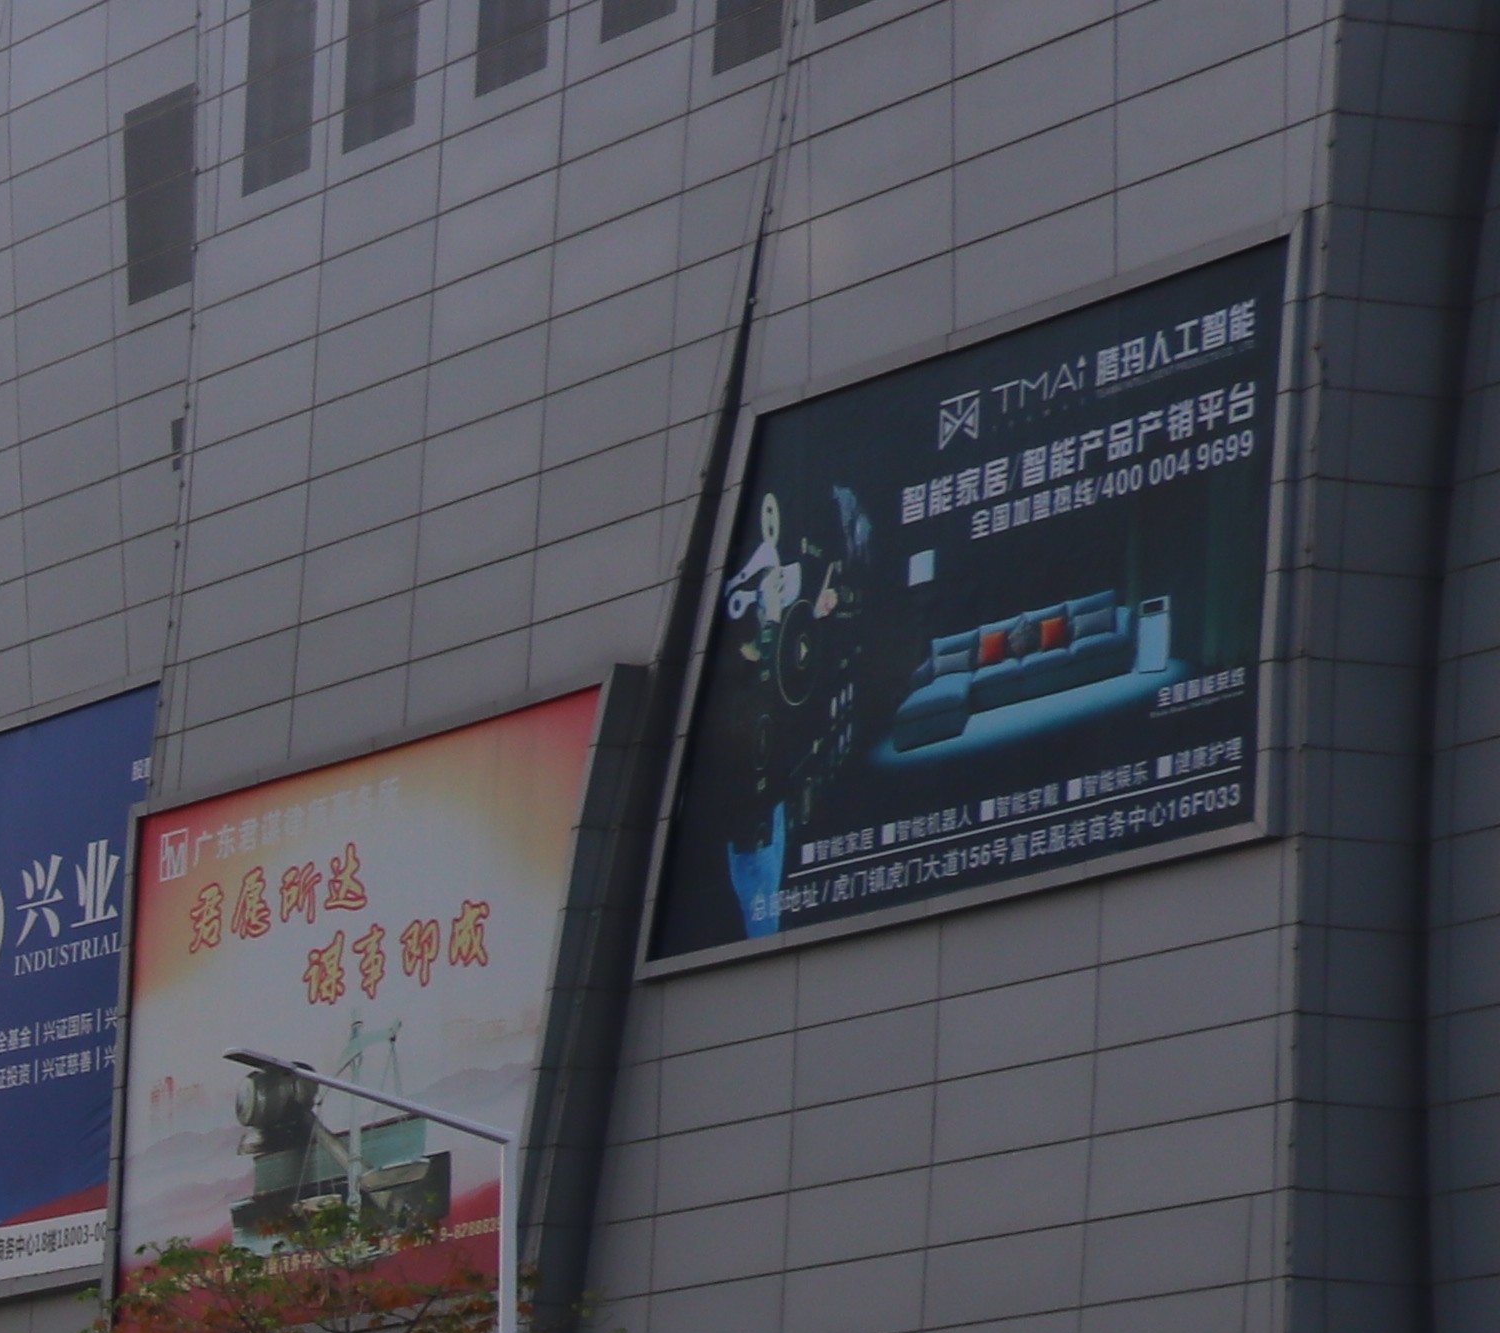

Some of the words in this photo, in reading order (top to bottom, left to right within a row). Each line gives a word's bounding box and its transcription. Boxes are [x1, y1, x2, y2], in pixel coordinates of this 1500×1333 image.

[190, 842, 367, 954] 君愿所达
[14, 942, 121, 977] INDUSTRIAL
